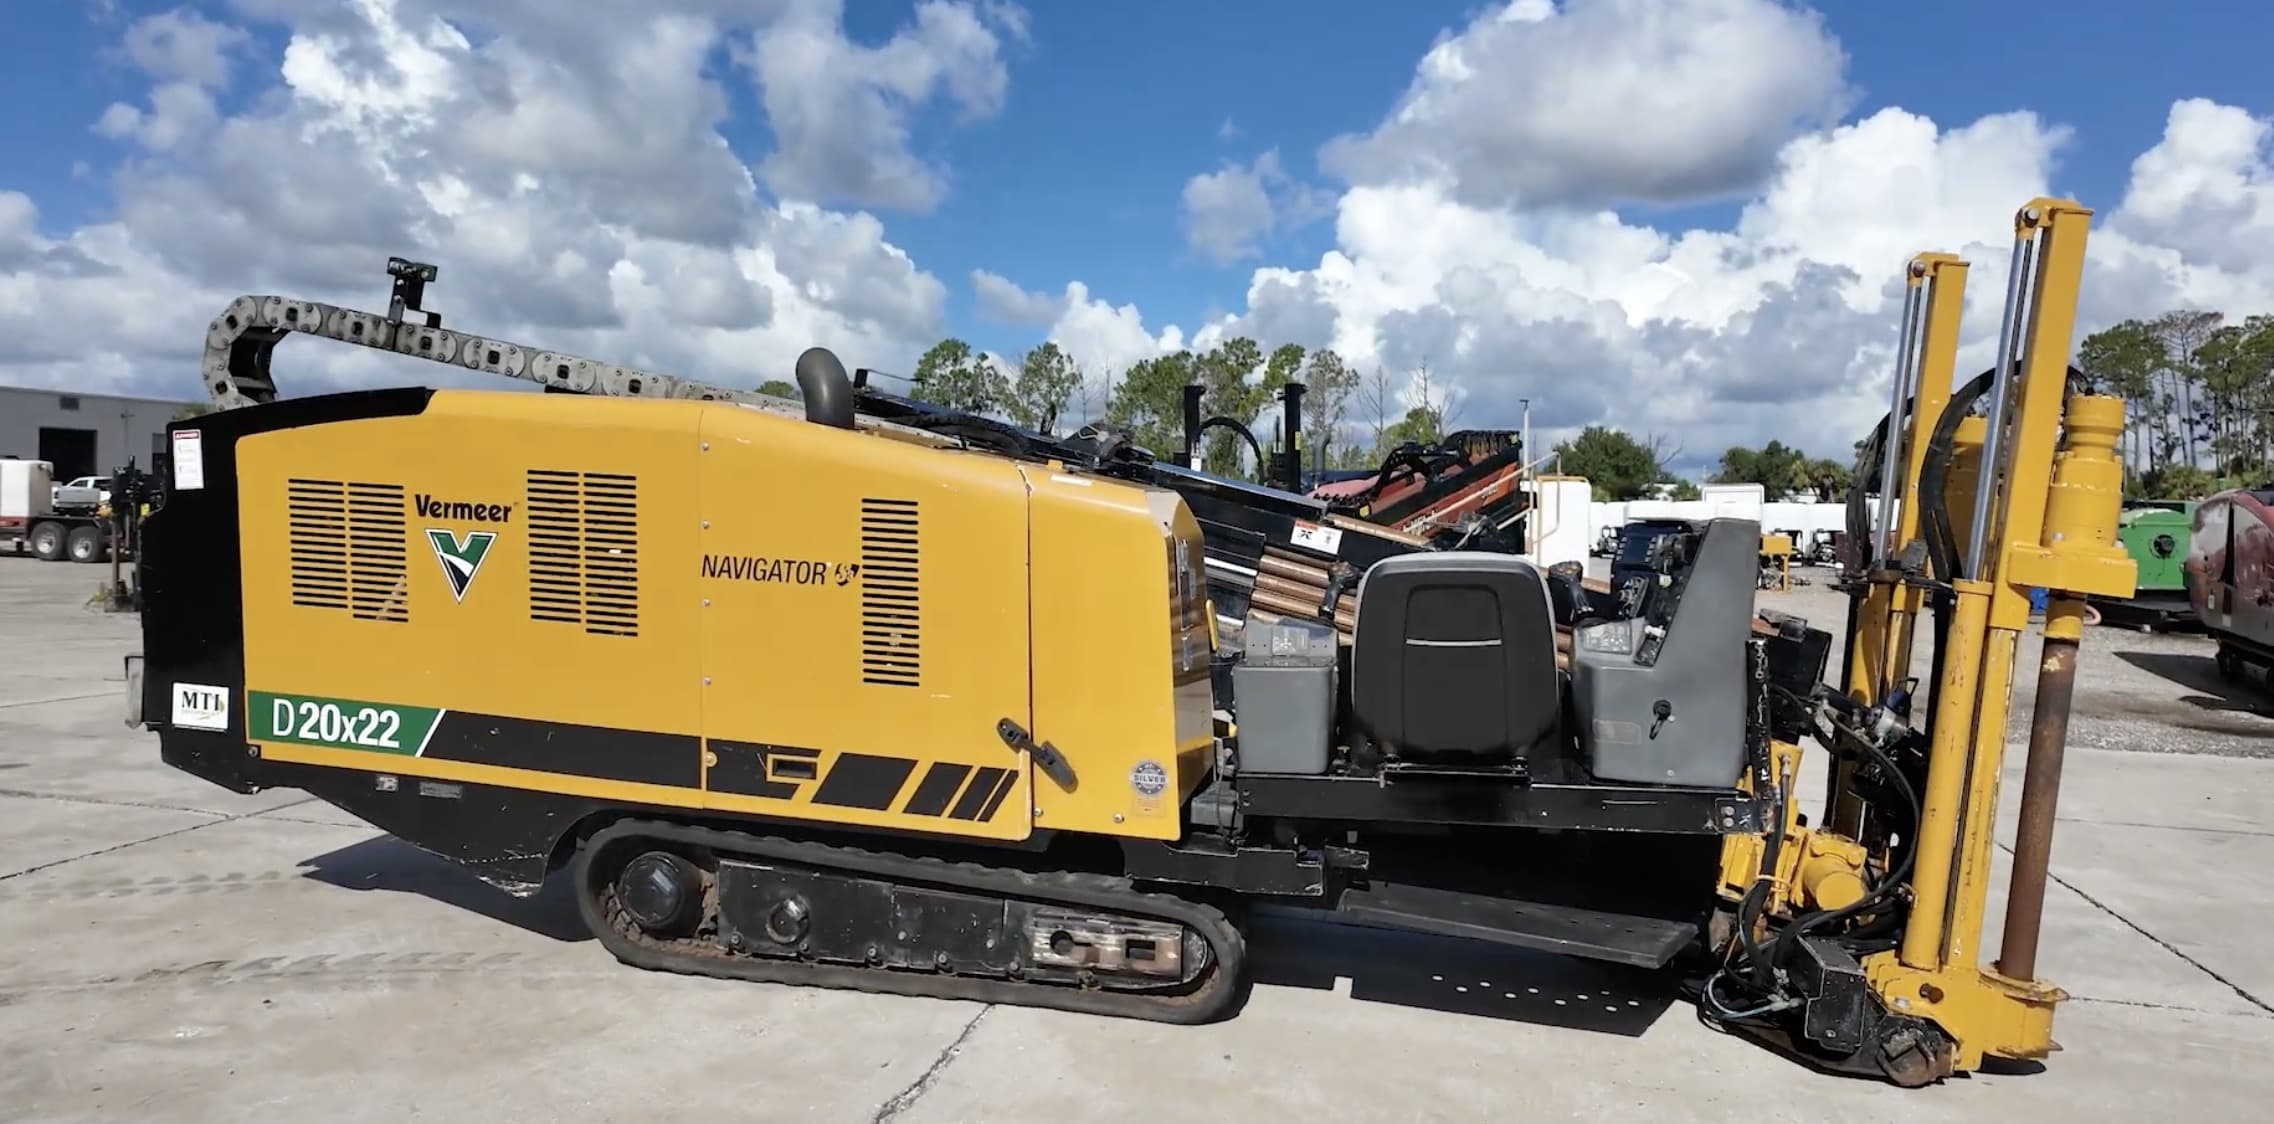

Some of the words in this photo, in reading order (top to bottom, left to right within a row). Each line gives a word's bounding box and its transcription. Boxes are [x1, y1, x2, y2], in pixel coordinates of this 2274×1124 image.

[415, 494, 512, 522] Vermeer
[701, 554, 827, 585] NAVIGATOR
[181, 690, 220, 711] MTI
[1134, 773, 1166, 784] SILVER
